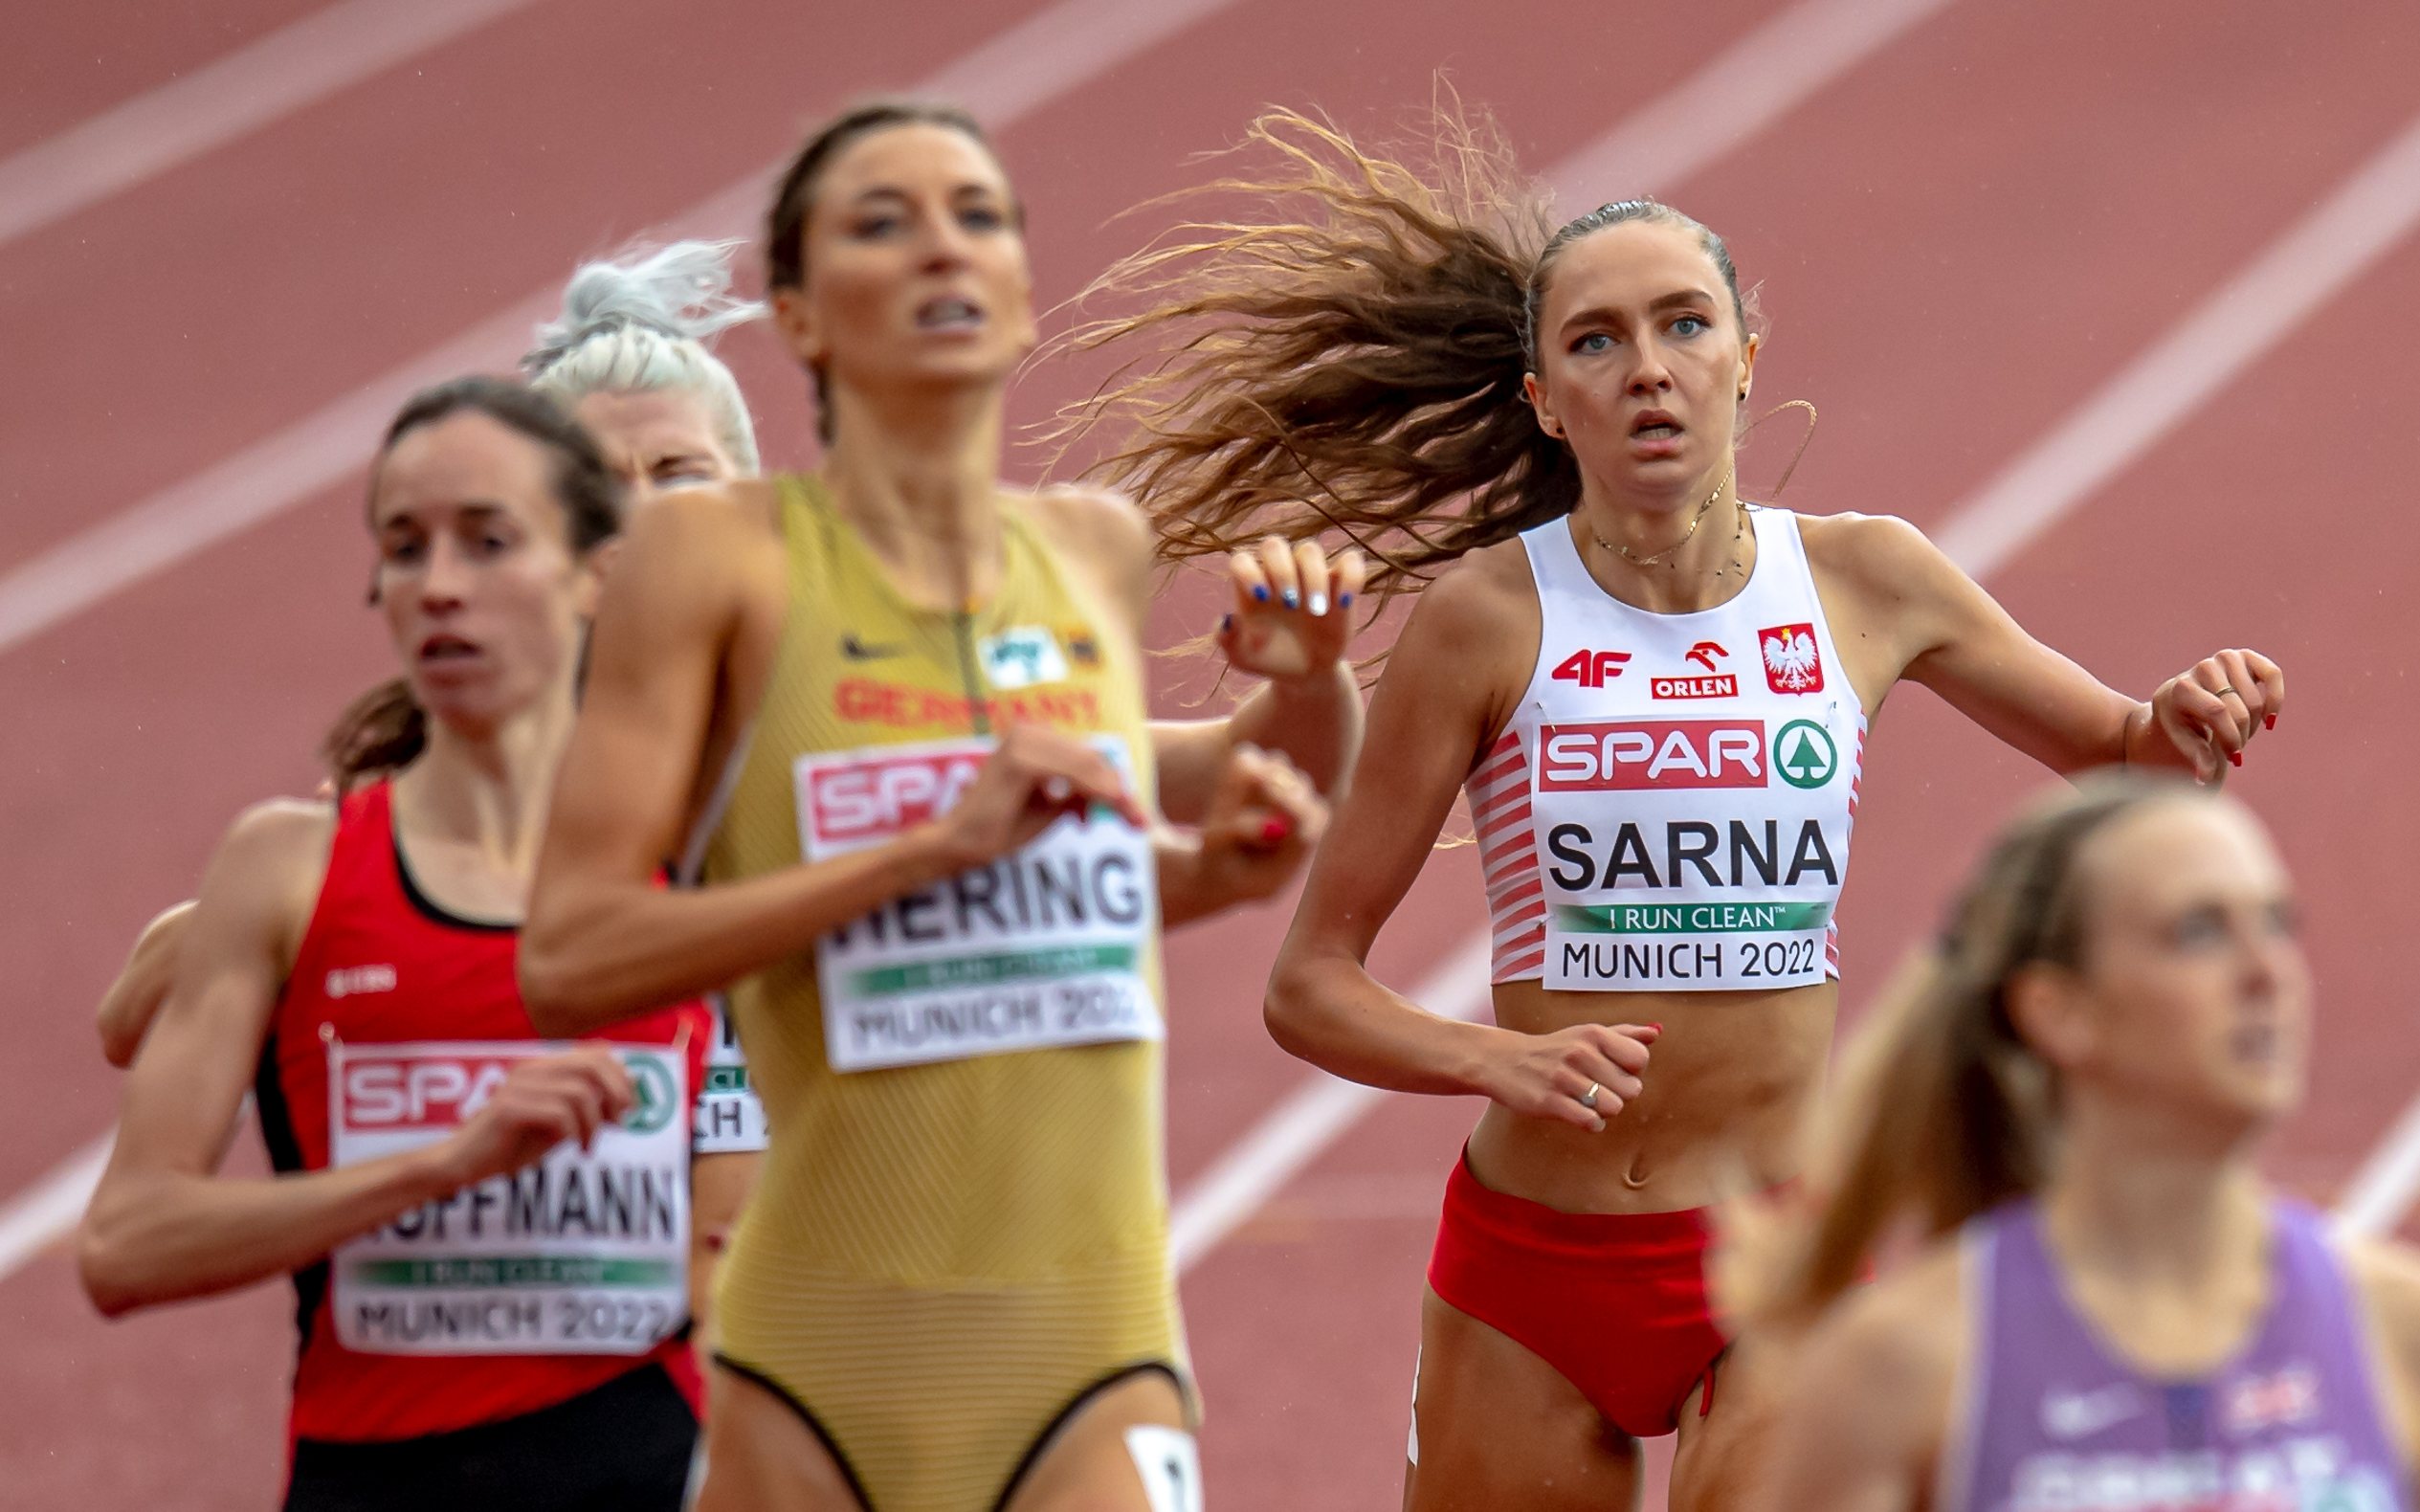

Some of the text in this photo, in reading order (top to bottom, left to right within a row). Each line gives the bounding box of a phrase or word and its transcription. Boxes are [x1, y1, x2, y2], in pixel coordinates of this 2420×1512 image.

[1551, 649, 1632, 688] 4F
[1654, 678, 1733, 698] ORLEN
[1545, 729, 1763, 782] SPAR
[1547, 819, 1838, 891] SARNA
[1610, 908, 1616, 930] I
[1625, 907, 1683, 930] RUN
[1563, 938, 1814, 979] MUNICH 2022
